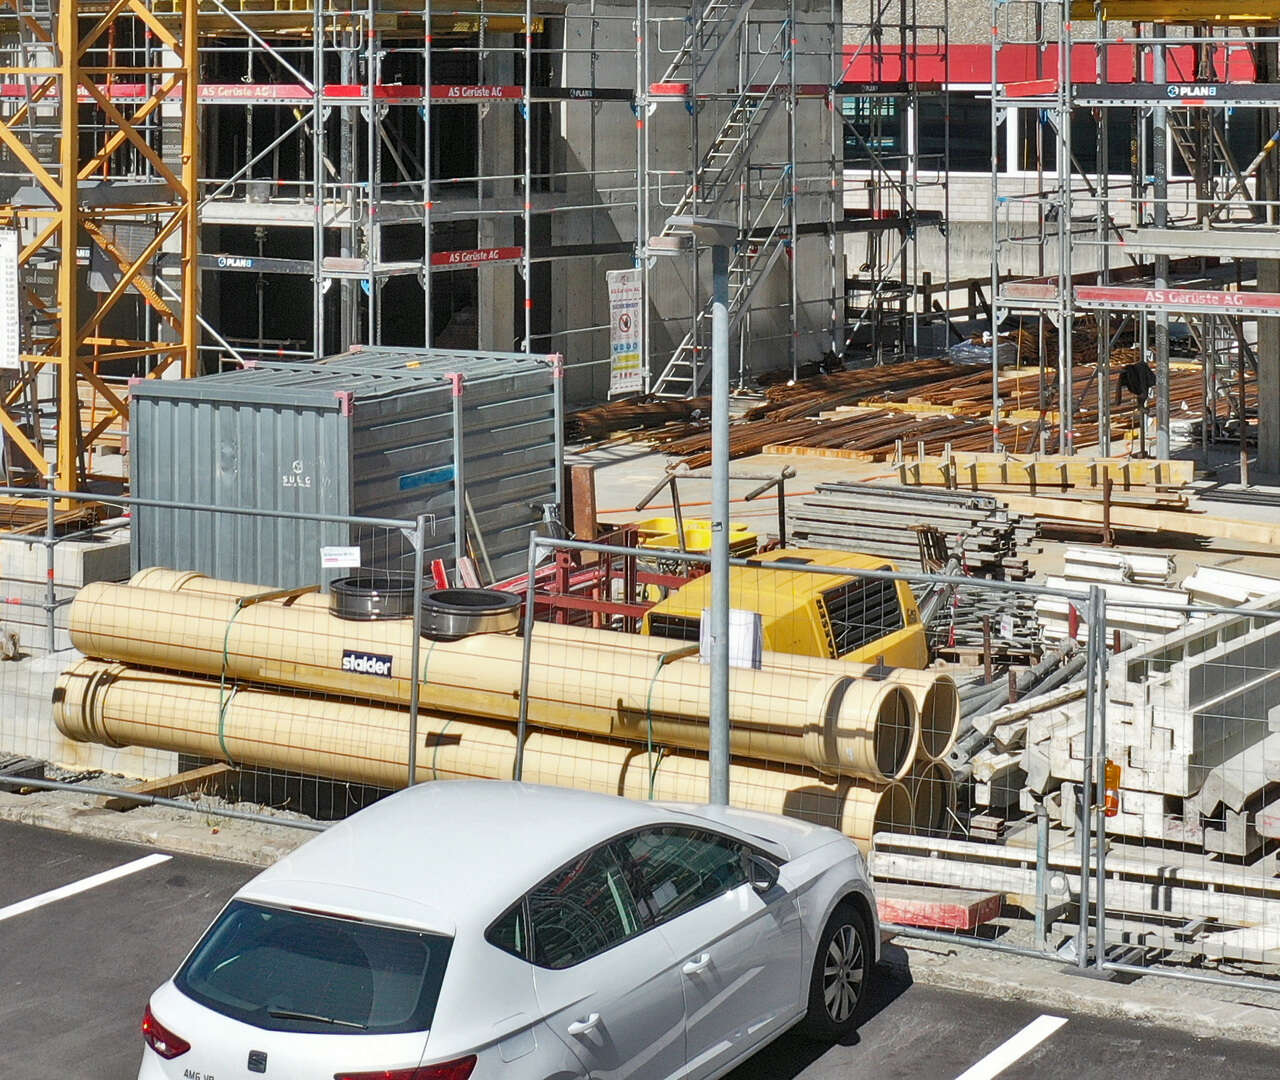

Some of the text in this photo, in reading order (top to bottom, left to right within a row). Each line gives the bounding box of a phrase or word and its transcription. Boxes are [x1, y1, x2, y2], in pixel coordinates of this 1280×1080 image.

[202, 86, 269, 97] AS Gerüste AG
[448, 87, 502, 97] AS Gerüste AG
[449, 250, 499, 263] AS Gerüste AG
[1145, 291, 1244, 305] AS Gerüste AG
[343, 654, 391, 675] stalder
